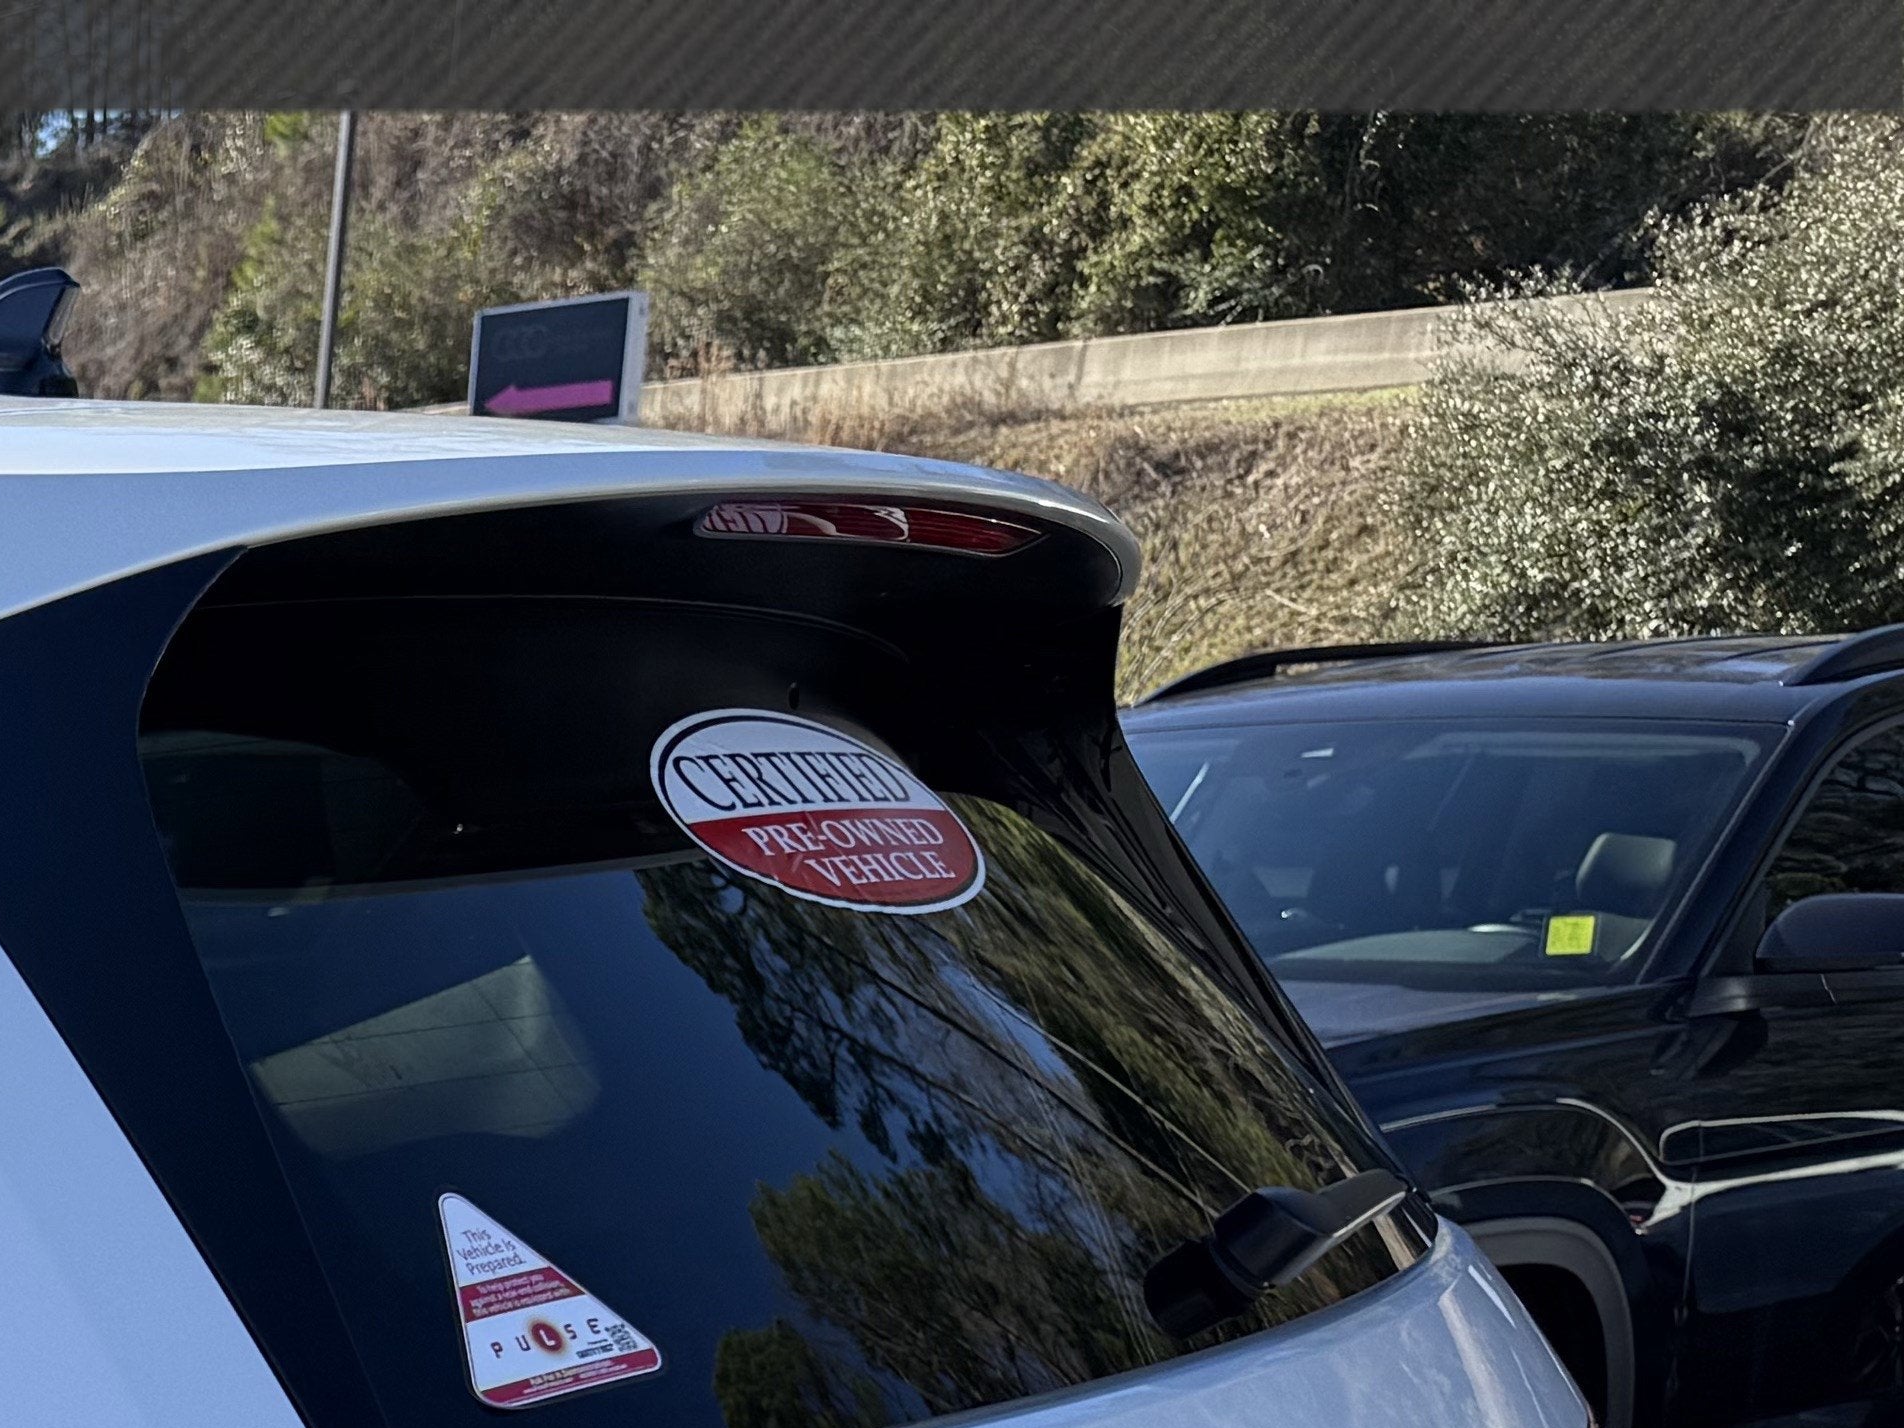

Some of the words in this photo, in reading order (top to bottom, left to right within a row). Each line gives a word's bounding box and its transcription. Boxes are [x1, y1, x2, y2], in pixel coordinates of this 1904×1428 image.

[672, 752, 912, 812] CERTIFIED
[742, 819, 944, 857] PRE-OWNED
[805, 851, 956, 887] VEHICLE
[457, 1242, 501, 1261] Vehicle
[462, 1227, 492, 1244] This
[490, 1318, 602, 1359] PULSE
